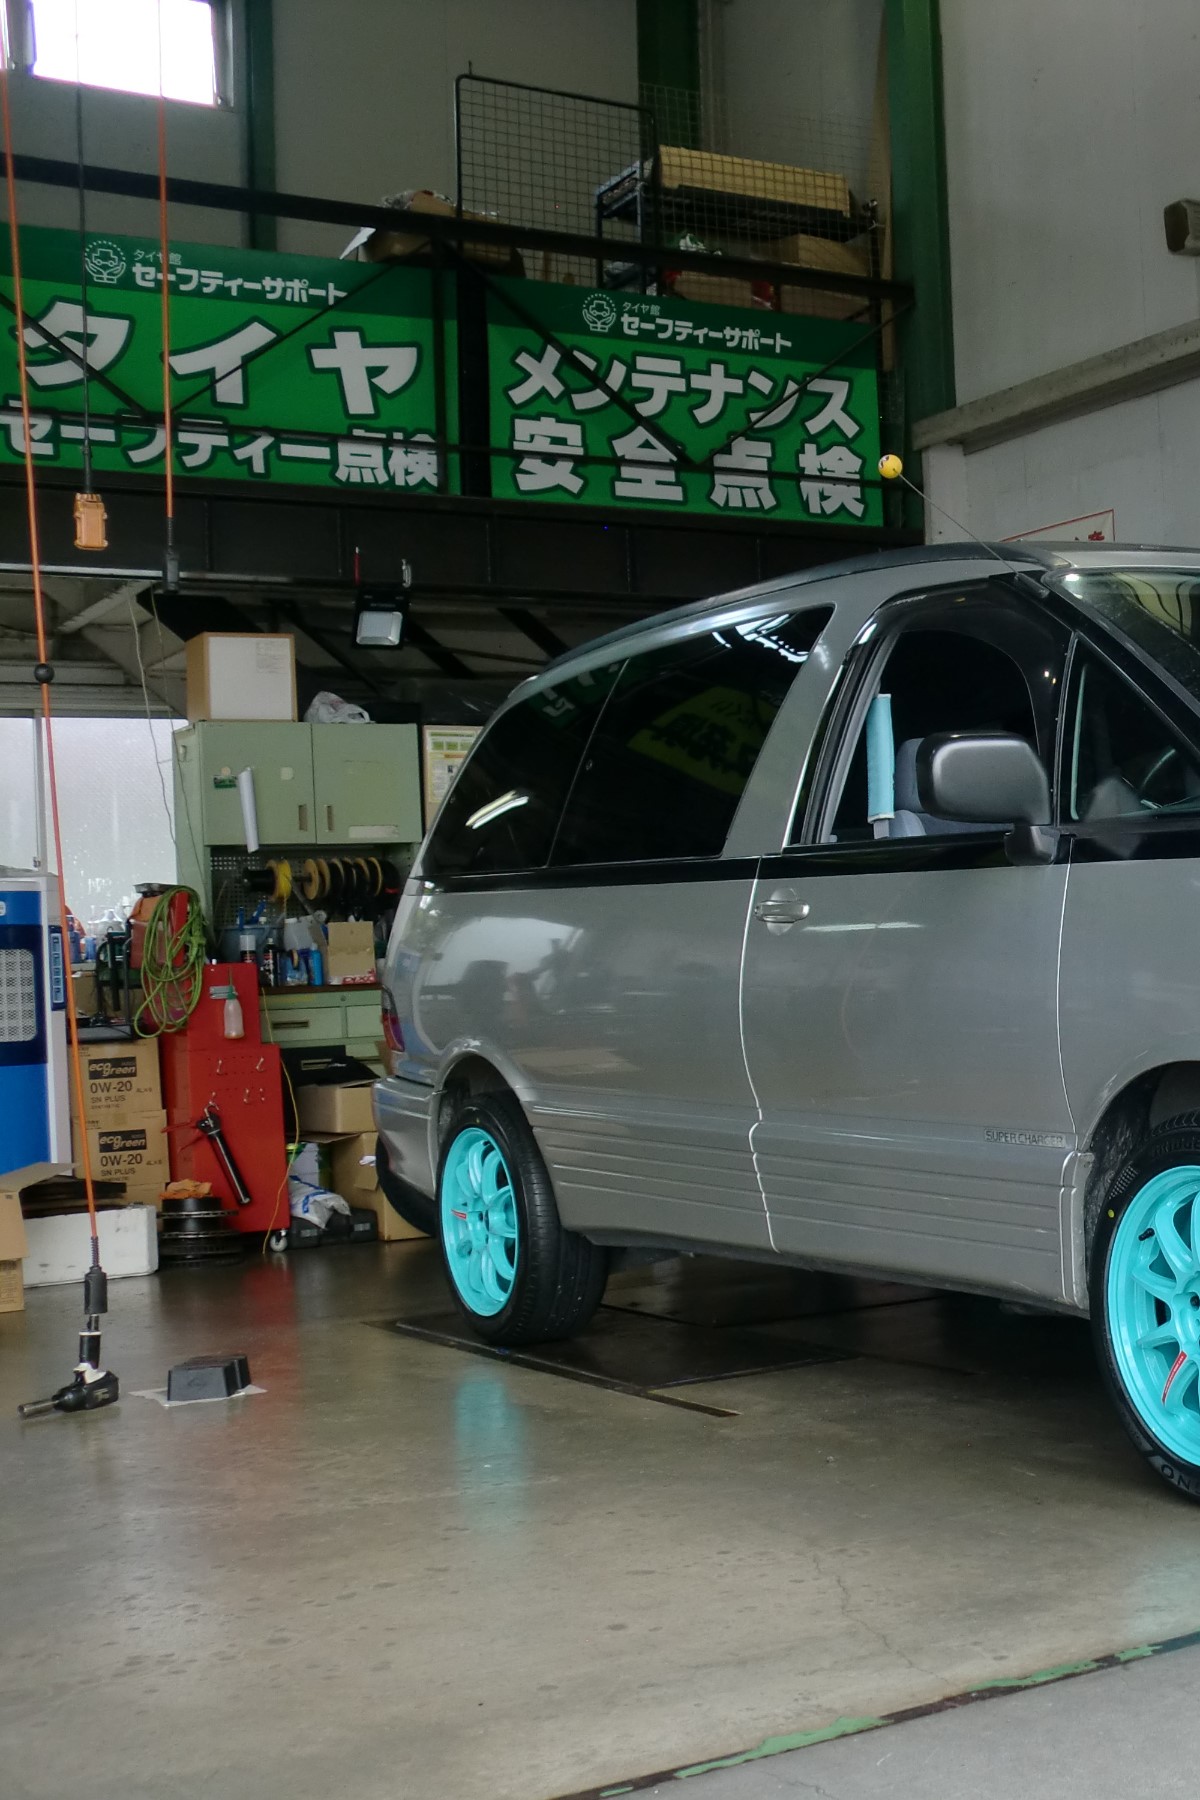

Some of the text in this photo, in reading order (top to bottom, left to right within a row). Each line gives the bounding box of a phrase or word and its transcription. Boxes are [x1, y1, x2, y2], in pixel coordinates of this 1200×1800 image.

[132, 262, 347, 306] セーフティーサポート
[622, 301, 661, 316] タイヤ館
[620, 313, 792, 353] セーフティーサポート
[18, 301, 418, 415] タイヤ
[508, 342, 861, 439] メンテナンス
[0, 400, 438, 487] セーフティー点検
[512, 414, 865, 518] 安全点検
[90, 1080, 132, 1094] 0W-20
[102, 1066, 136, 1077] green
[100, 1153, 143, 1167] 0W-20
